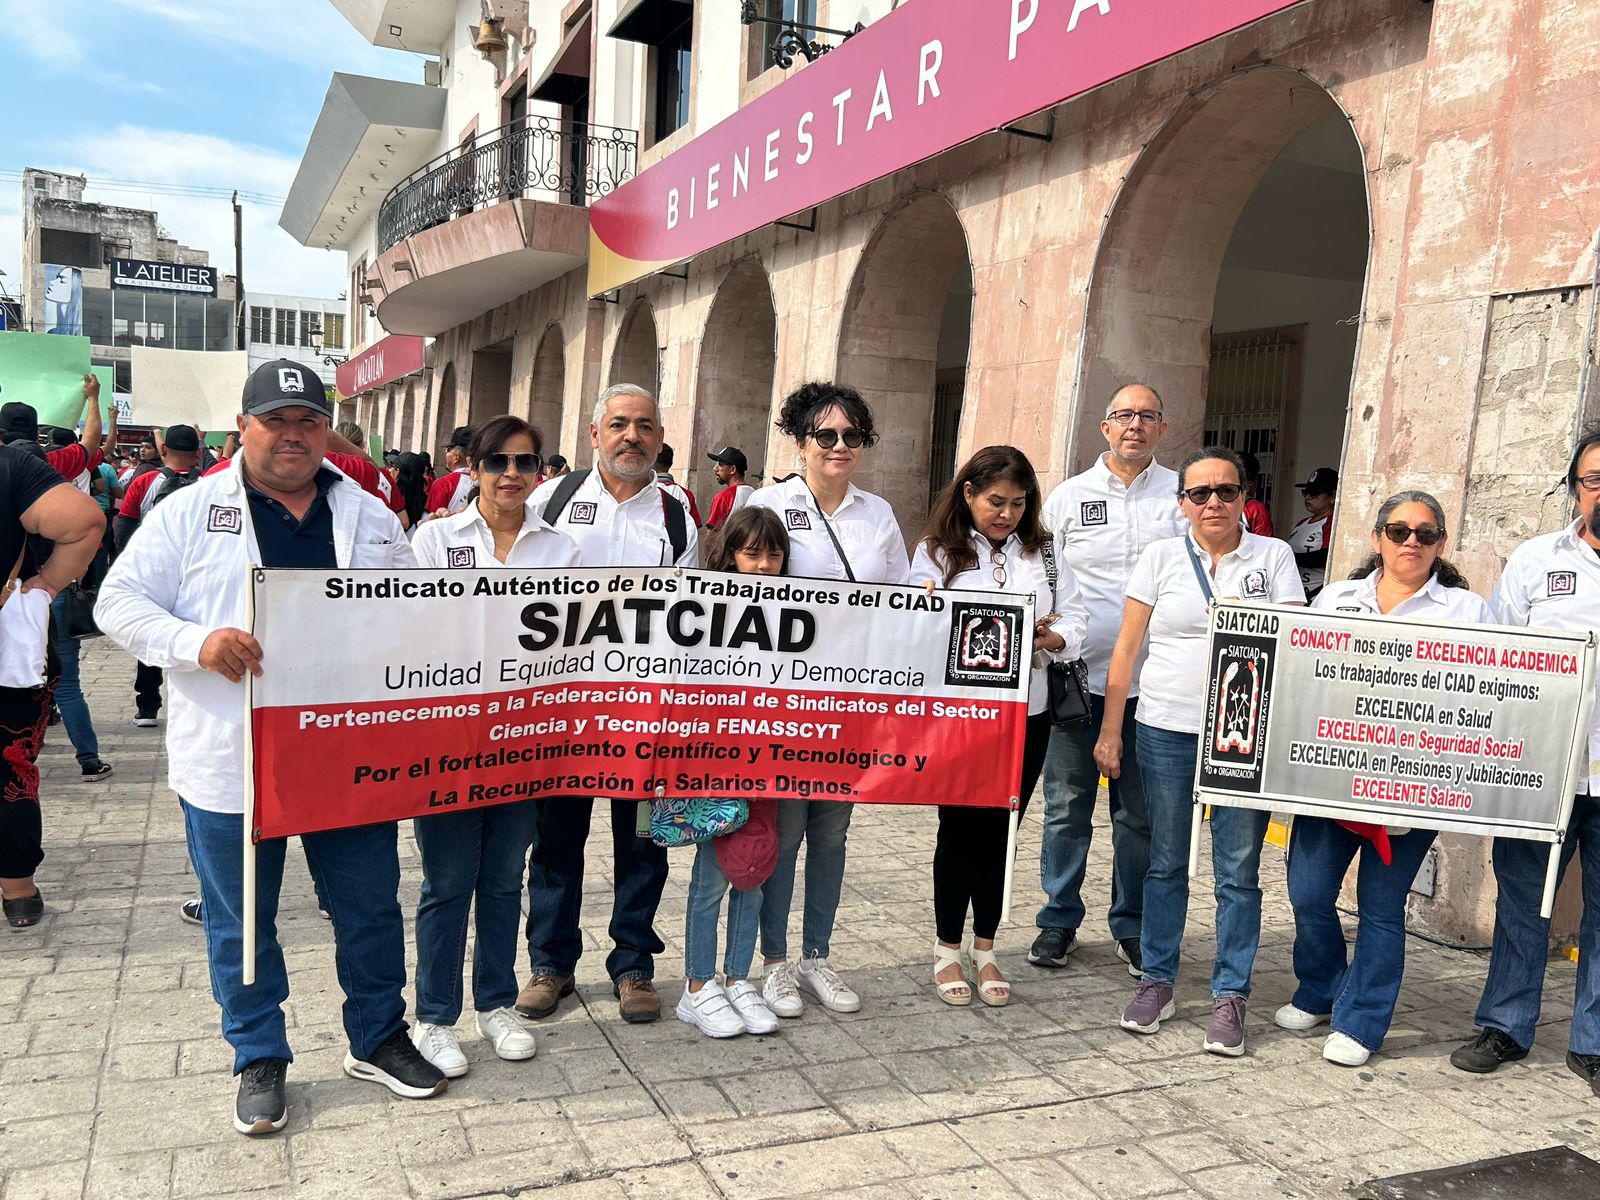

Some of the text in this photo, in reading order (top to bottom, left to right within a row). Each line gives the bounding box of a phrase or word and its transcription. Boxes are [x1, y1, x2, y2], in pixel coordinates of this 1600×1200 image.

[666, 39, 943, 230] BIENESTAR
[118, 279, 209, 291] BEAUTY ACADEMY
[325, 574, 945, 613] Sindicato Auténtico de los Trabajadores del CIAD
[969, 608, 1005, 617] SIATCIAD
[517, 598, 816, 653] SIATCIAD
[1216, 610, 1280, 635] SIATCIAD
[951, 626, 959, 649] UNIDAD
[1012, 633, 1020, 671] DEMOCRACIA
[1227, 645, 1260, 660] SIATCIAD
[1290, 627, 1578, 675] CONACYT nos exige EXCELENCIA ACADEMICA
[385, 650, 925, 690] Unidad Equidad Organización y Democracia
[1314, 658, 1540, 701] Los trabajadores del CIAD exigimos:
[299, 686, 999, 730] Pertenecemos a la Federación Nacional de Sindicatos del Sector
[489, 715, 842, 741] Ciencia y Tecnología FENASSCYT
[1208, 678, 1217, 724] UNIDAD
[1257, 690, 1270, 759] DEMOCRACIA
[1355, 696, 1493, 729] EXCELENCIA en Salud
[1317, 719, 1523, 759] EXCELENCIA en Seguridad Social
[353, 740, 927, 784] Por el fortalecimiento Científico y Tecnológico y
[1289, 743, 1543, 789] EXCELENCIA en Pensiones y Jubilaciones
[428, 772, 859, 807] La Recuperación de Salarios Dignos.
[1353, 778, 1473, 809] EXCELENTE Salario
